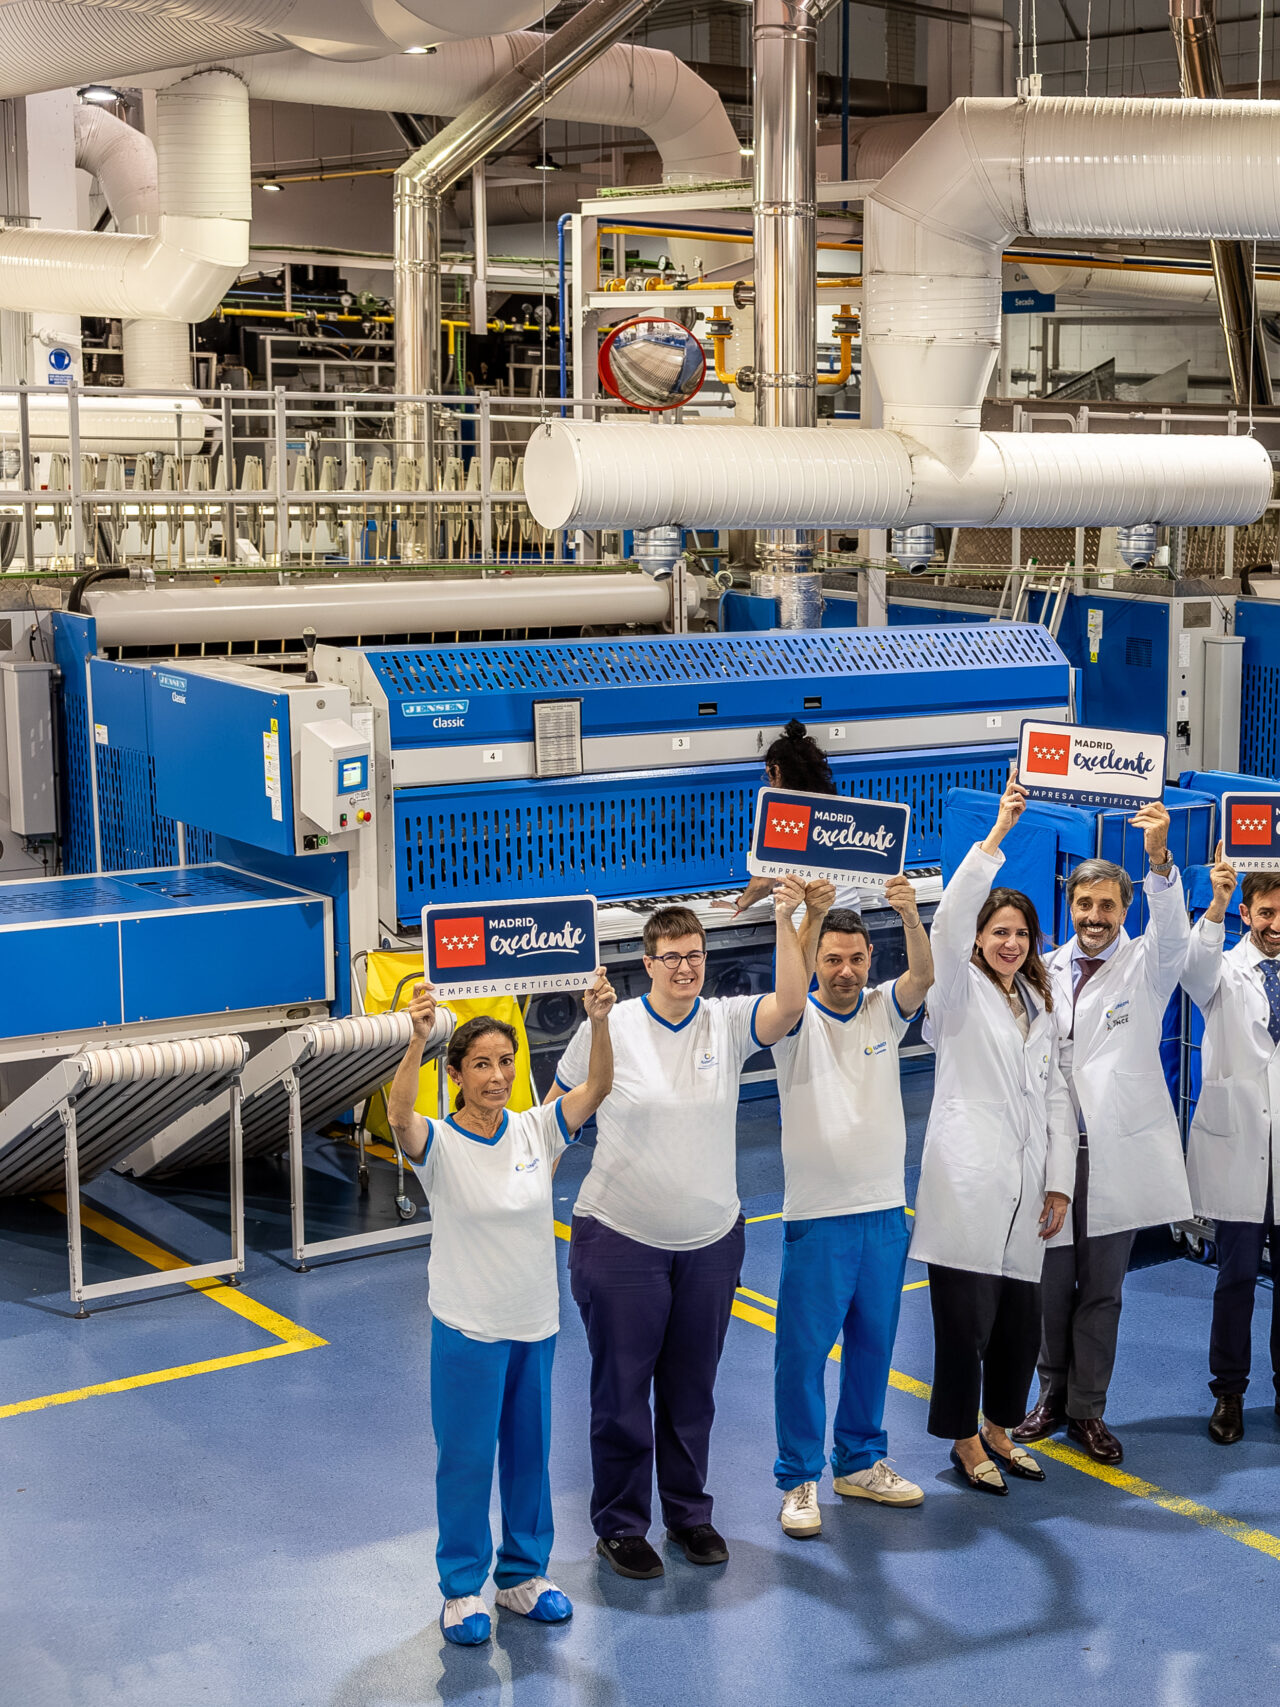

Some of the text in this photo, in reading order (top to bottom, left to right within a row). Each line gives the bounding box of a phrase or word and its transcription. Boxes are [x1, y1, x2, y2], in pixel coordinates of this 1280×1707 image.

[1015, 297, 1035, 306] Secado
[160, 676, 186, 688] JENSEN
[404, 702, 466, 714] JENSEN
[432, 717, 465, 728] Classic
[1074, 739, 1113, 750] MADRID
[1073, 749, 1155, 774] excelente
[1081, 794, 1148, 808] CERTIFICAD
[814, 810, 854, 824] MADRID
[812, 822, 896, 850] excelente
[818, 871, 884, 886] CERTIFICAD
[488, 917, 535, 929] MADRID
[490, 921, 586, 956] excelente
[439, 977, 589, 997] EMPRESA CERTIFICADA
